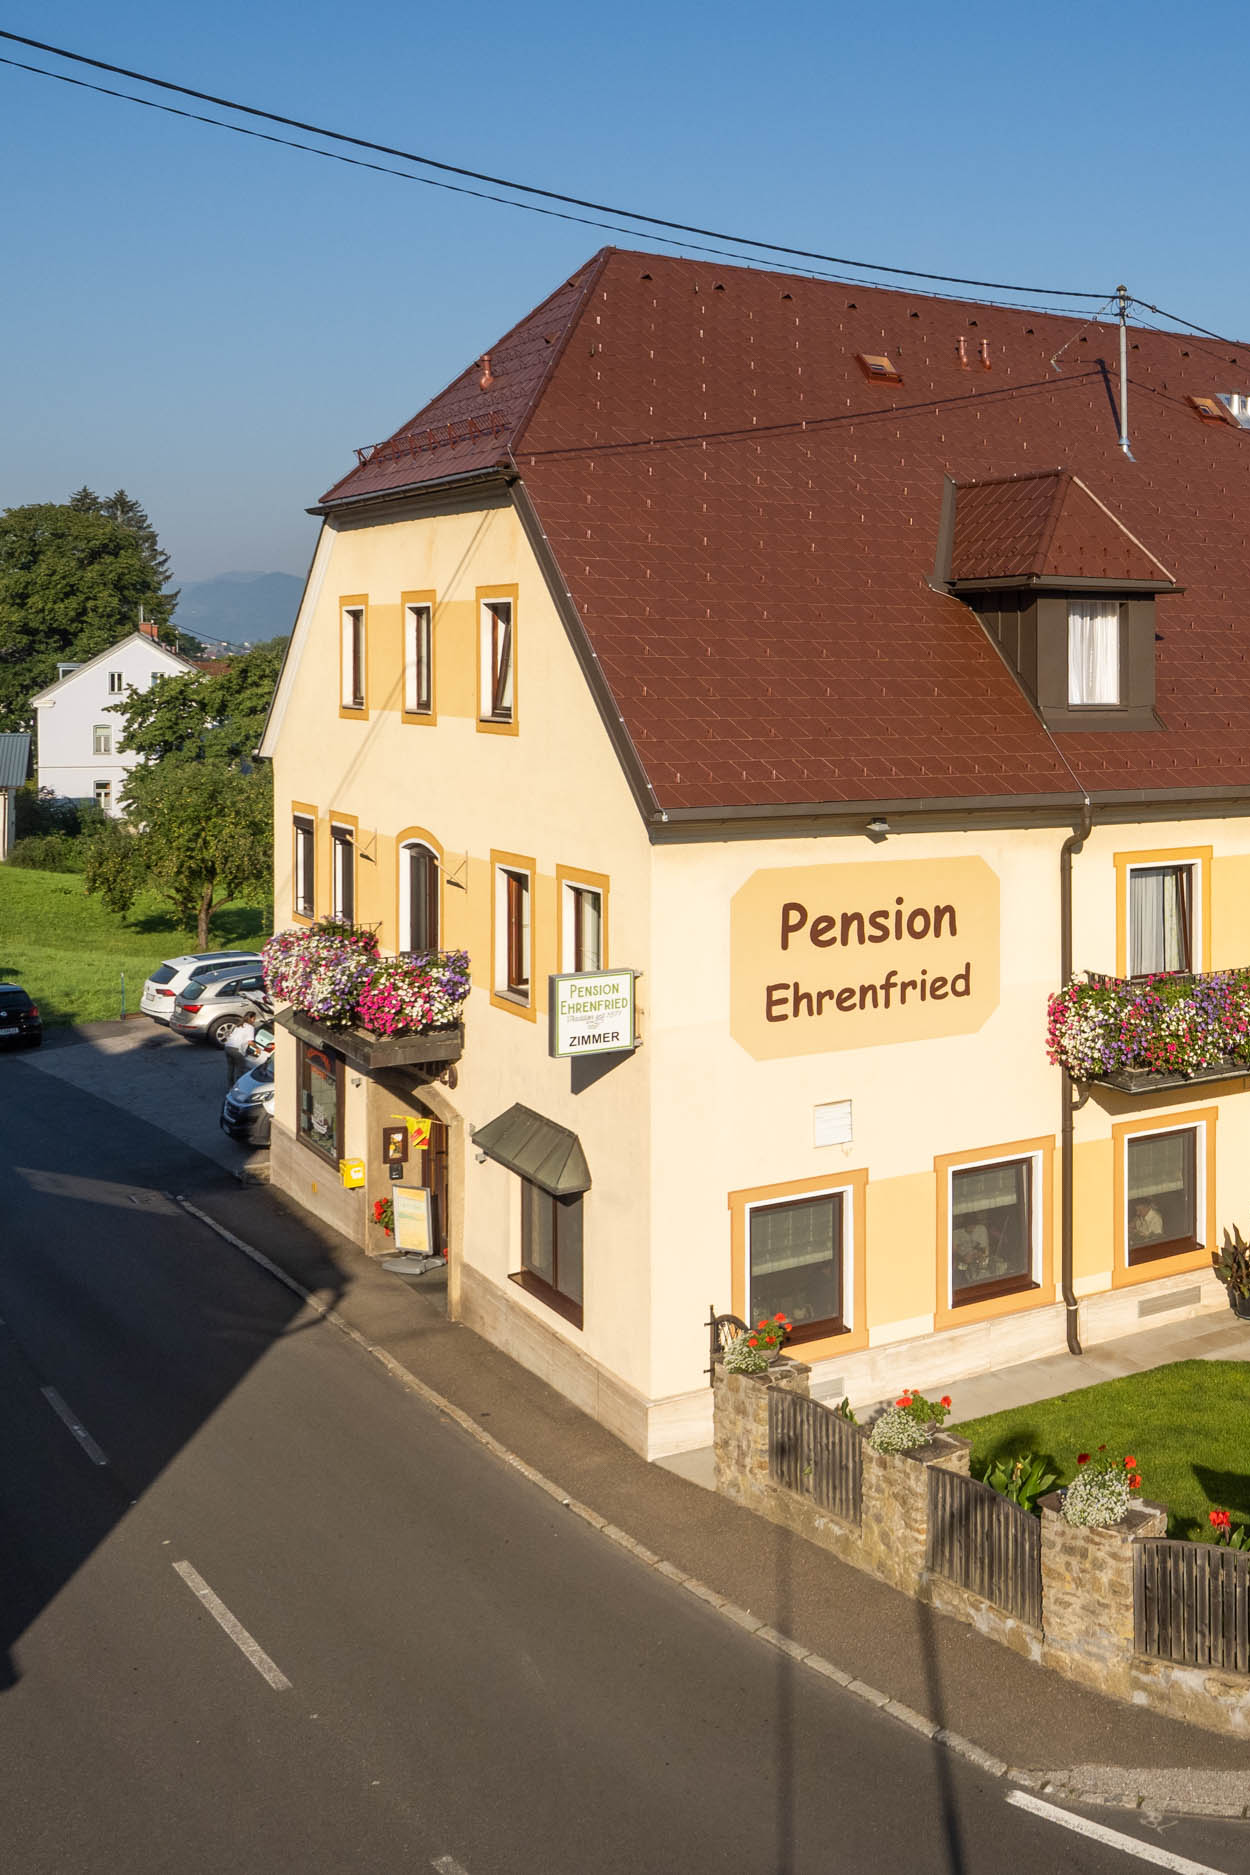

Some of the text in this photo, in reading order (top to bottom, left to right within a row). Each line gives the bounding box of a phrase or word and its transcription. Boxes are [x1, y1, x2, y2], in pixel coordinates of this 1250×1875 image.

[780, 896, 957, 951] Pension
[570, 983, 620, 998] PENSION
[765, 961, 971, 1023] Ehrenfried
[560, 997, 628, 1015] EHRENFRIED
[568, 1031, 620, 1047] ZIMMER
